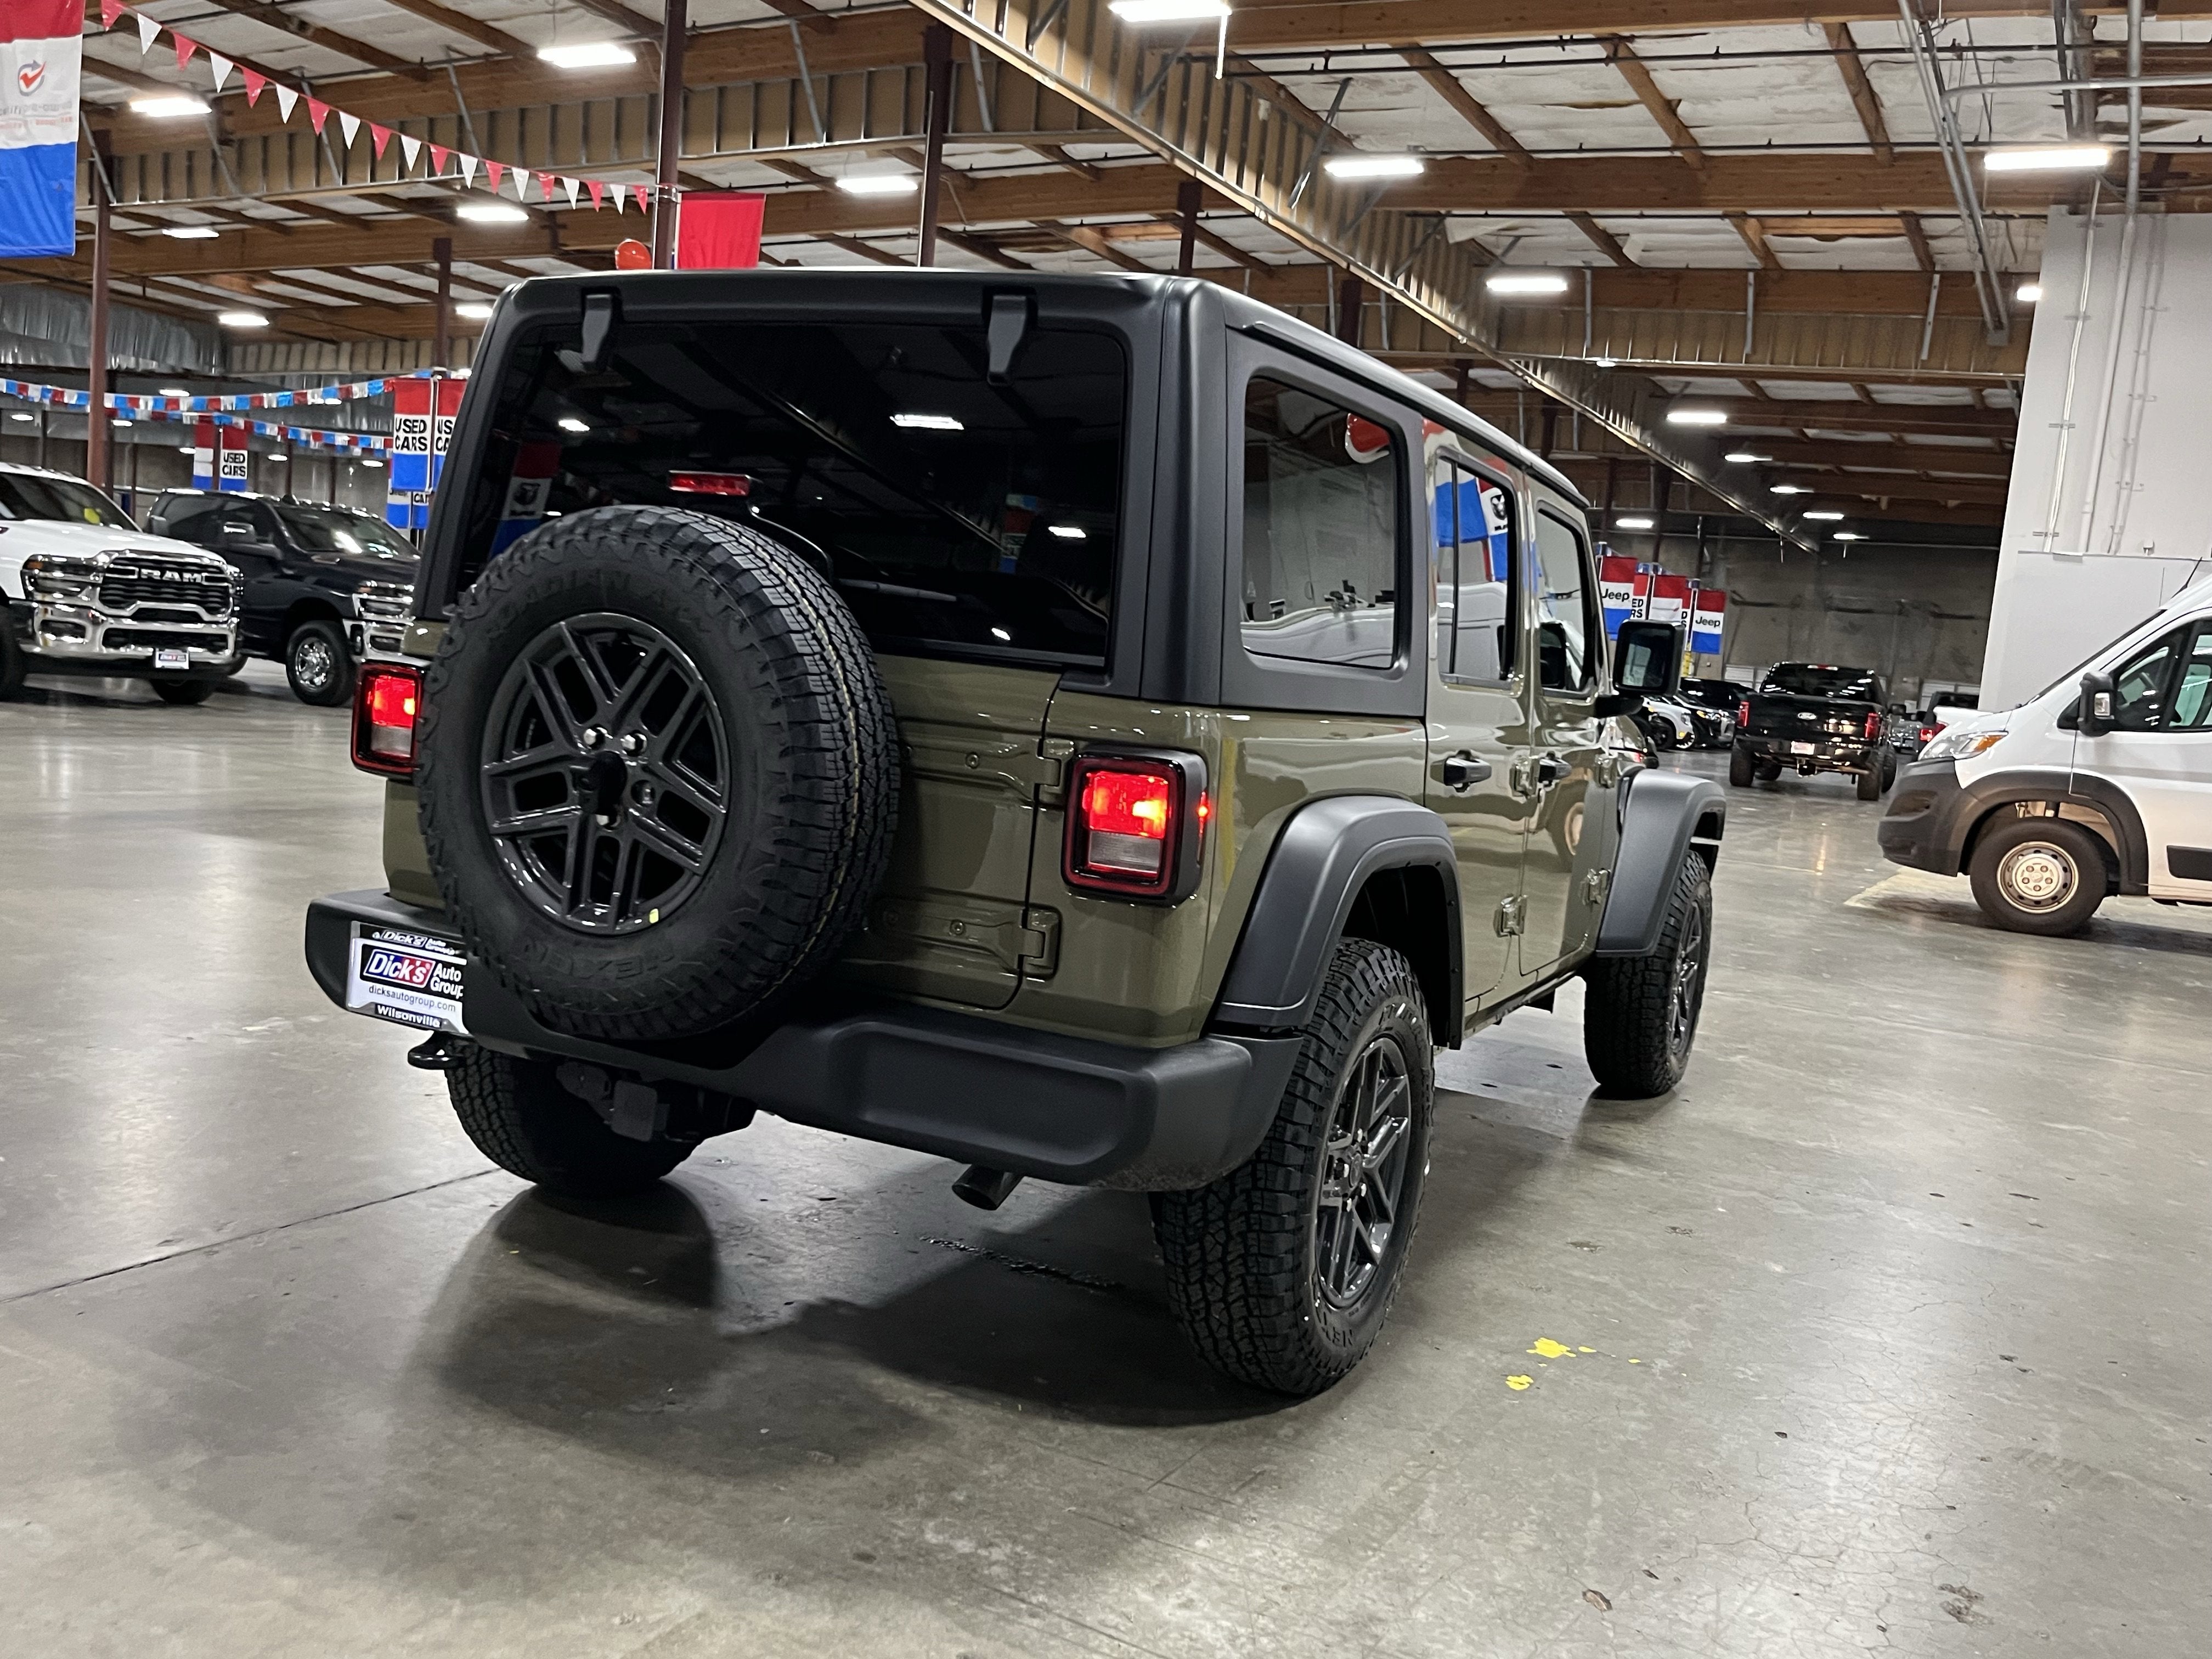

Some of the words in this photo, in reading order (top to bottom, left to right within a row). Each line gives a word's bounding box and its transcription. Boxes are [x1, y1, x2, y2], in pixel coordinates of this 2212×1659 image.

[395, 418, 427, 434] USED
[437, 419, 453, 435] US
[394, 436, 427, 452] CARS
[224, 452, 246, 464] USED
[140, 569, 202, 582] RAM
[1602, 589, 1629, 602] Jeep
[1632, 599, 1644, 607] ED
[1631, 609, 1643, 618] RS
[1695, 617, 1720, 627] Jeep
[383, 931, 424, 946] Dick's
[369, 953, 427, 983] Dick's
[433, 963, 461, 982] Auto
[369, 985, 456, 1012] dicksautogroup.com
[377, 1005, 441, 1028] Wilsonville
